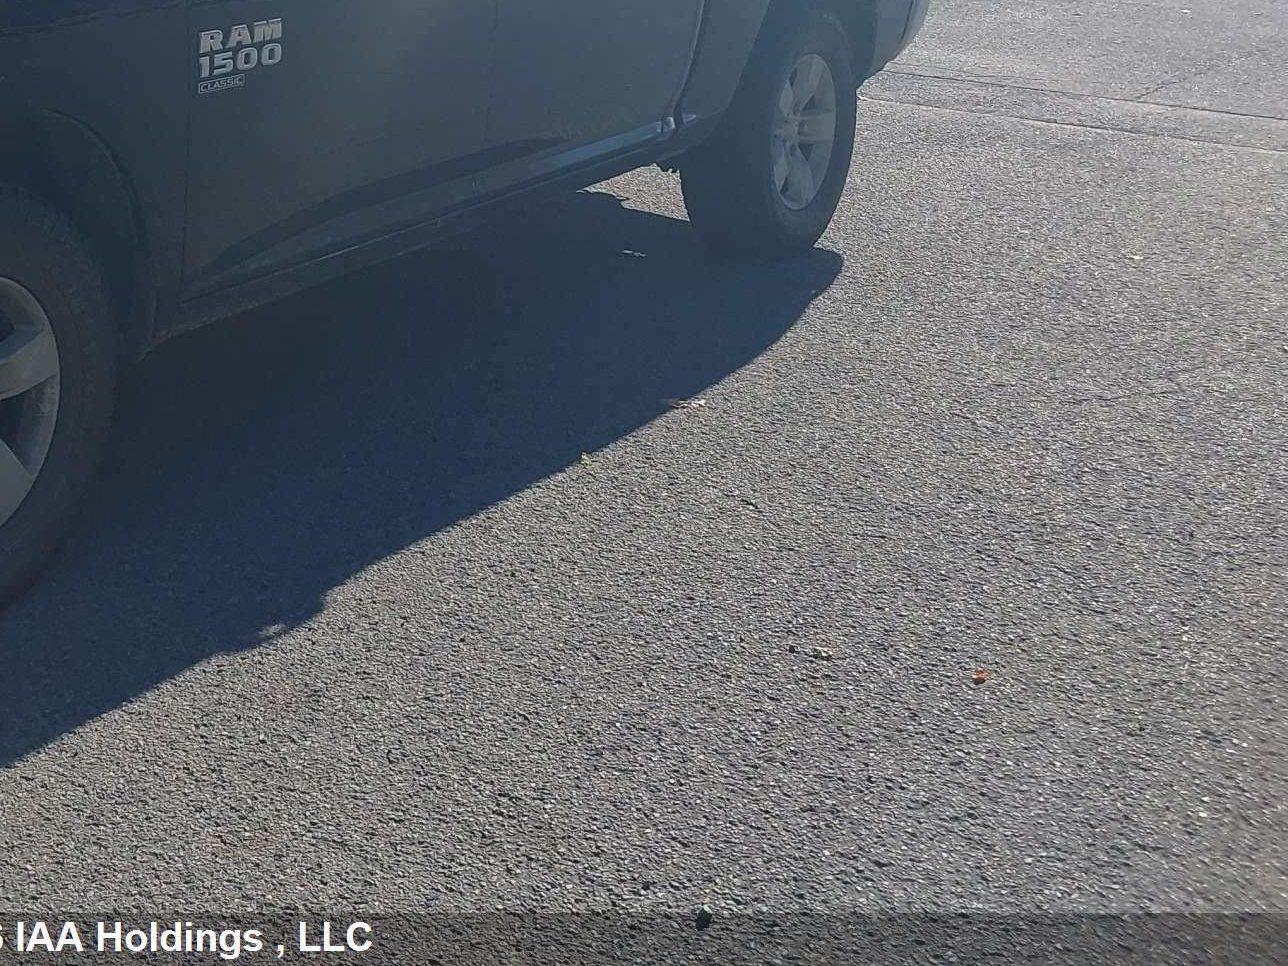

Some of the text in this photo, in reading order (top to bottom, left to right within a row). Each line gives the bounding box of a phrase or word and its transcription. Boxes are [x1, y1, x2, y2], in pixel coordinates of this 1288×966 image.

[199, 17, 283, 54] RAM
[198, 43, 282, 78] 1500
[199, 75, 244, 93] CLASSIC
